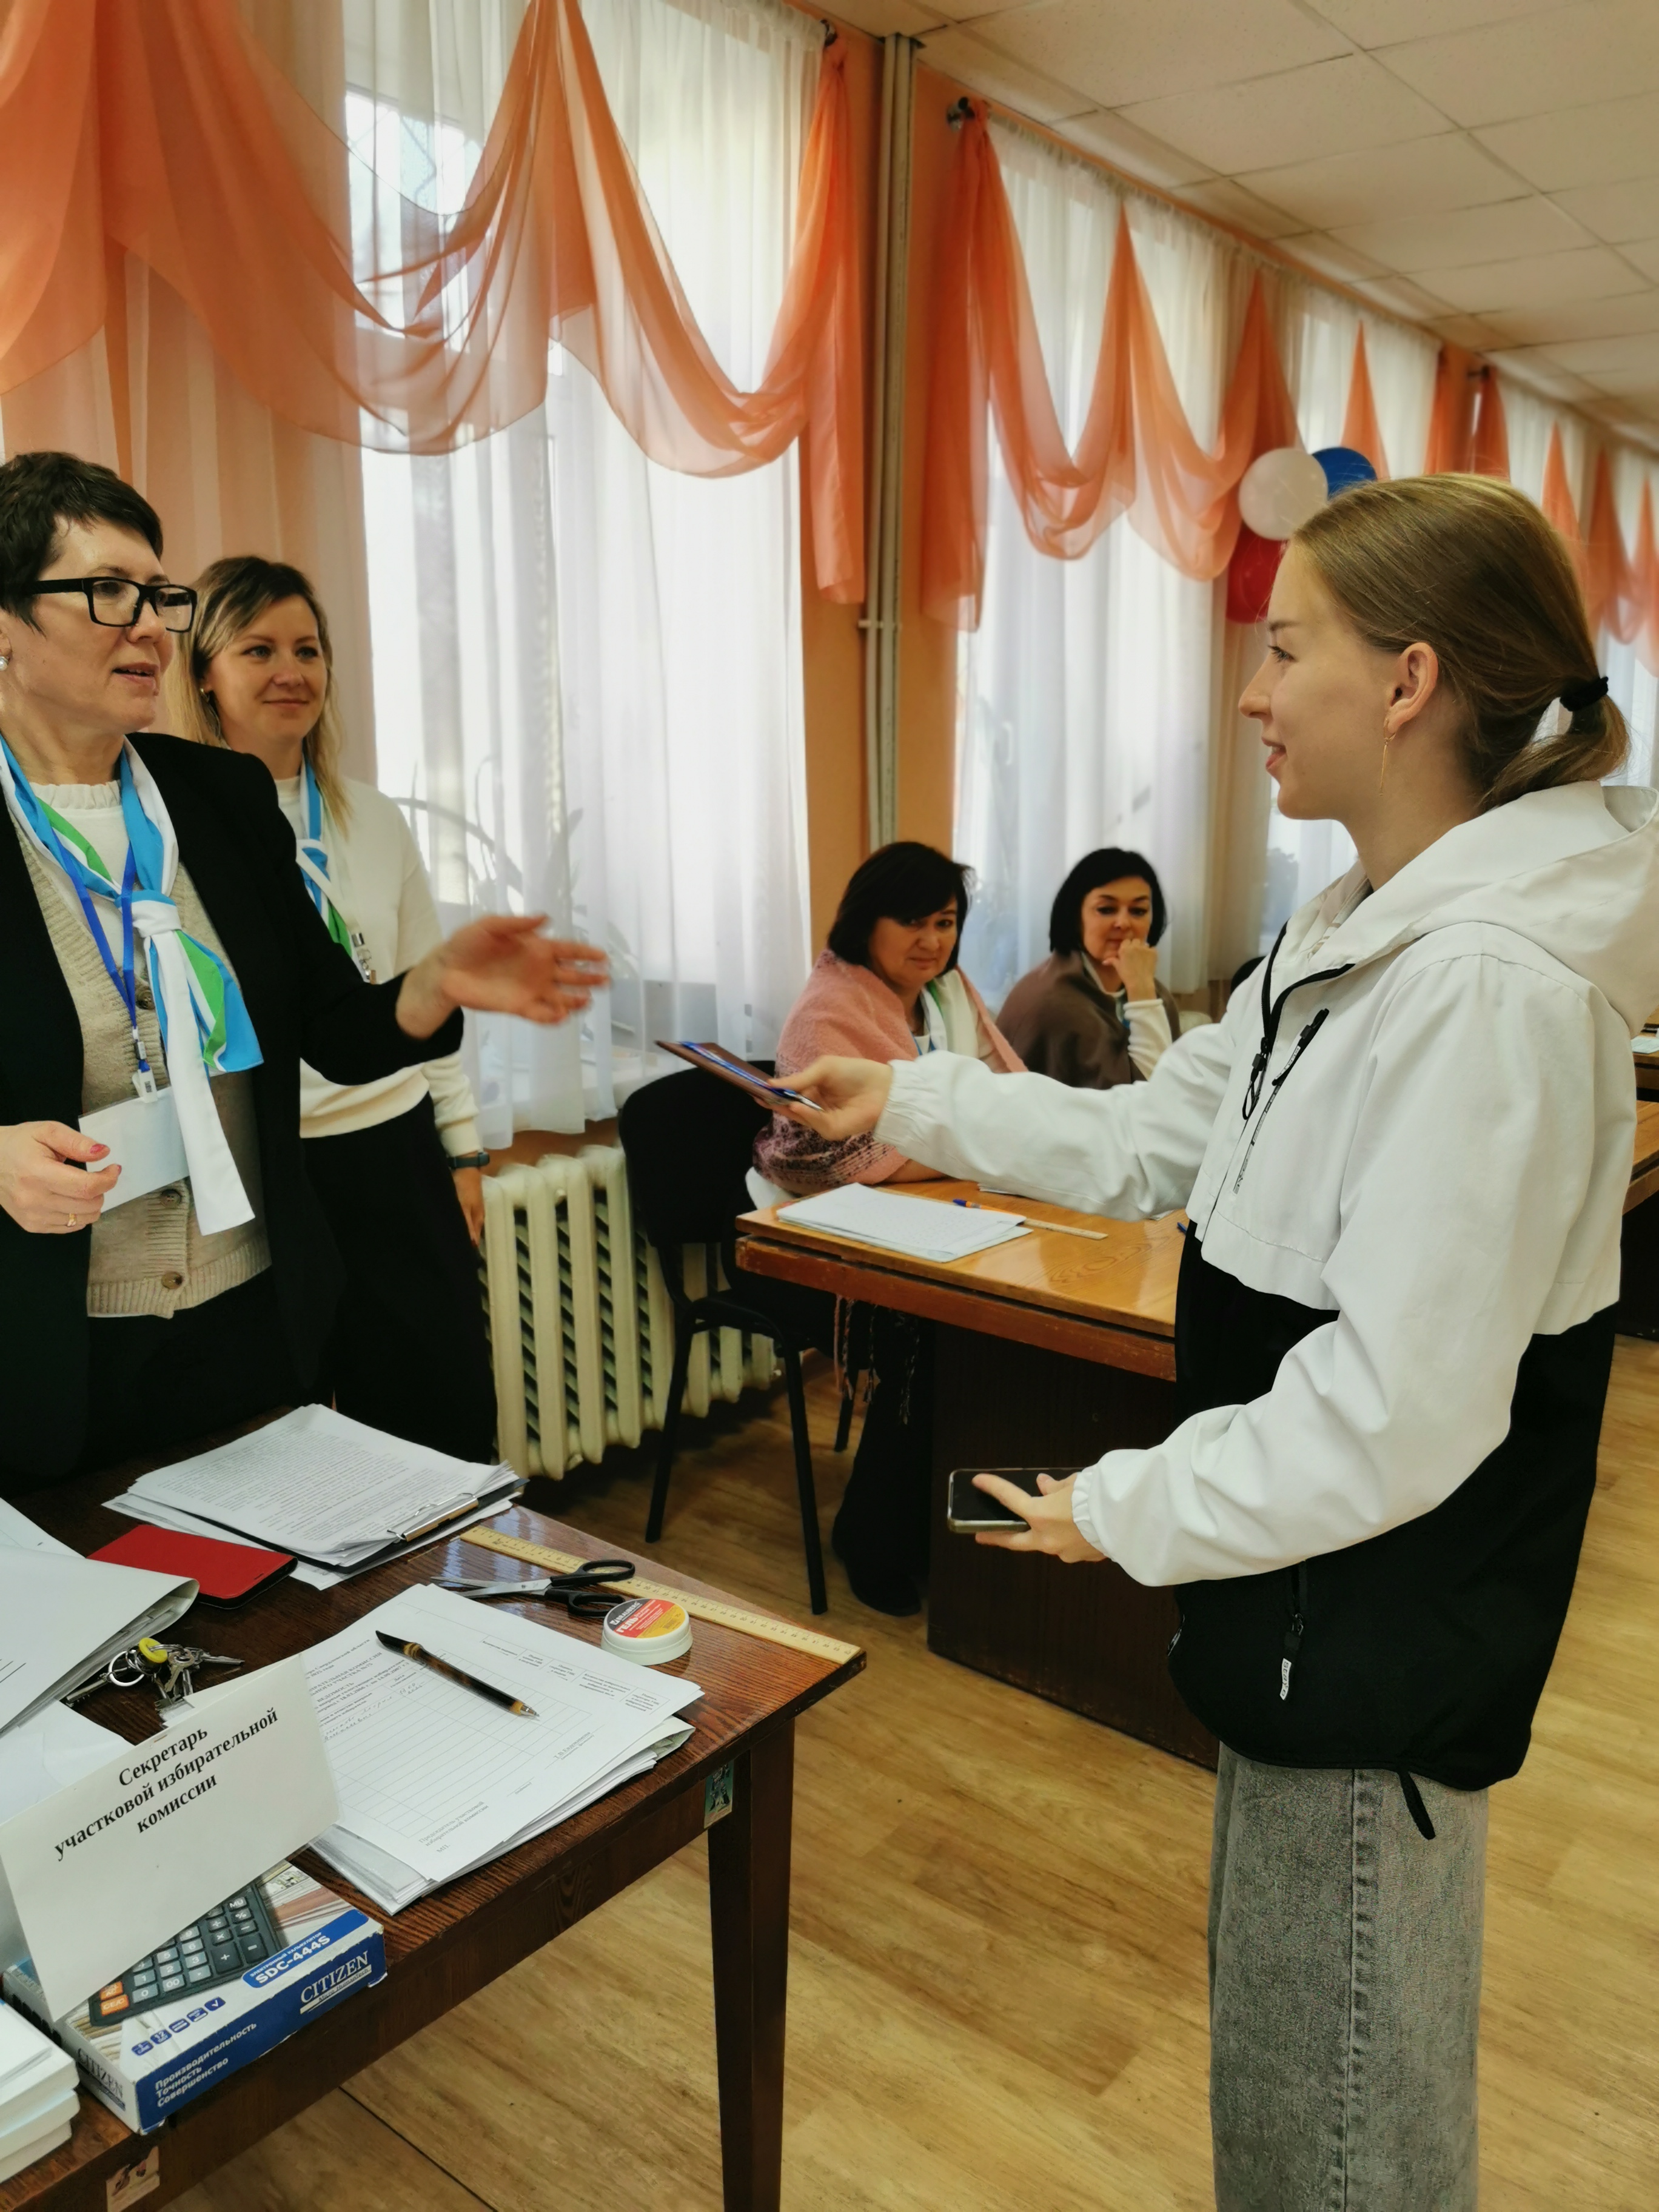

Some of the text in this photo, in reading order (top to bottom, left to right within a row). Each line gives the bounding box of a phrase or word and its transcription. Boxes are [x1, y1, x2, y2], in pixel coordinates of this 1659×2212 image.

[615, 1617, 638, 1633] ГЕЛЬ
[616, 1601, 641, 1622] BRAUBERG
[119, 1727, 208, 1786] Секретарь
[54, 1706, 279, 1862] участковой избирательной
[136, 1774, 218, 1834] комиссии
[229, 1899, 244, 1908] MU
[249, 1952, 288, 1978] ЭЛЕКТРОННЫЙ
[255, 1935, 330, 1984] SDC-444S
[301, 1950, 369, 2003] CITIZEN
[155, 2023, 256, 2091] Производительность
[156, 2066, 202, 2099] Точность
[157, 2057, 229, 2108] Совершенство
